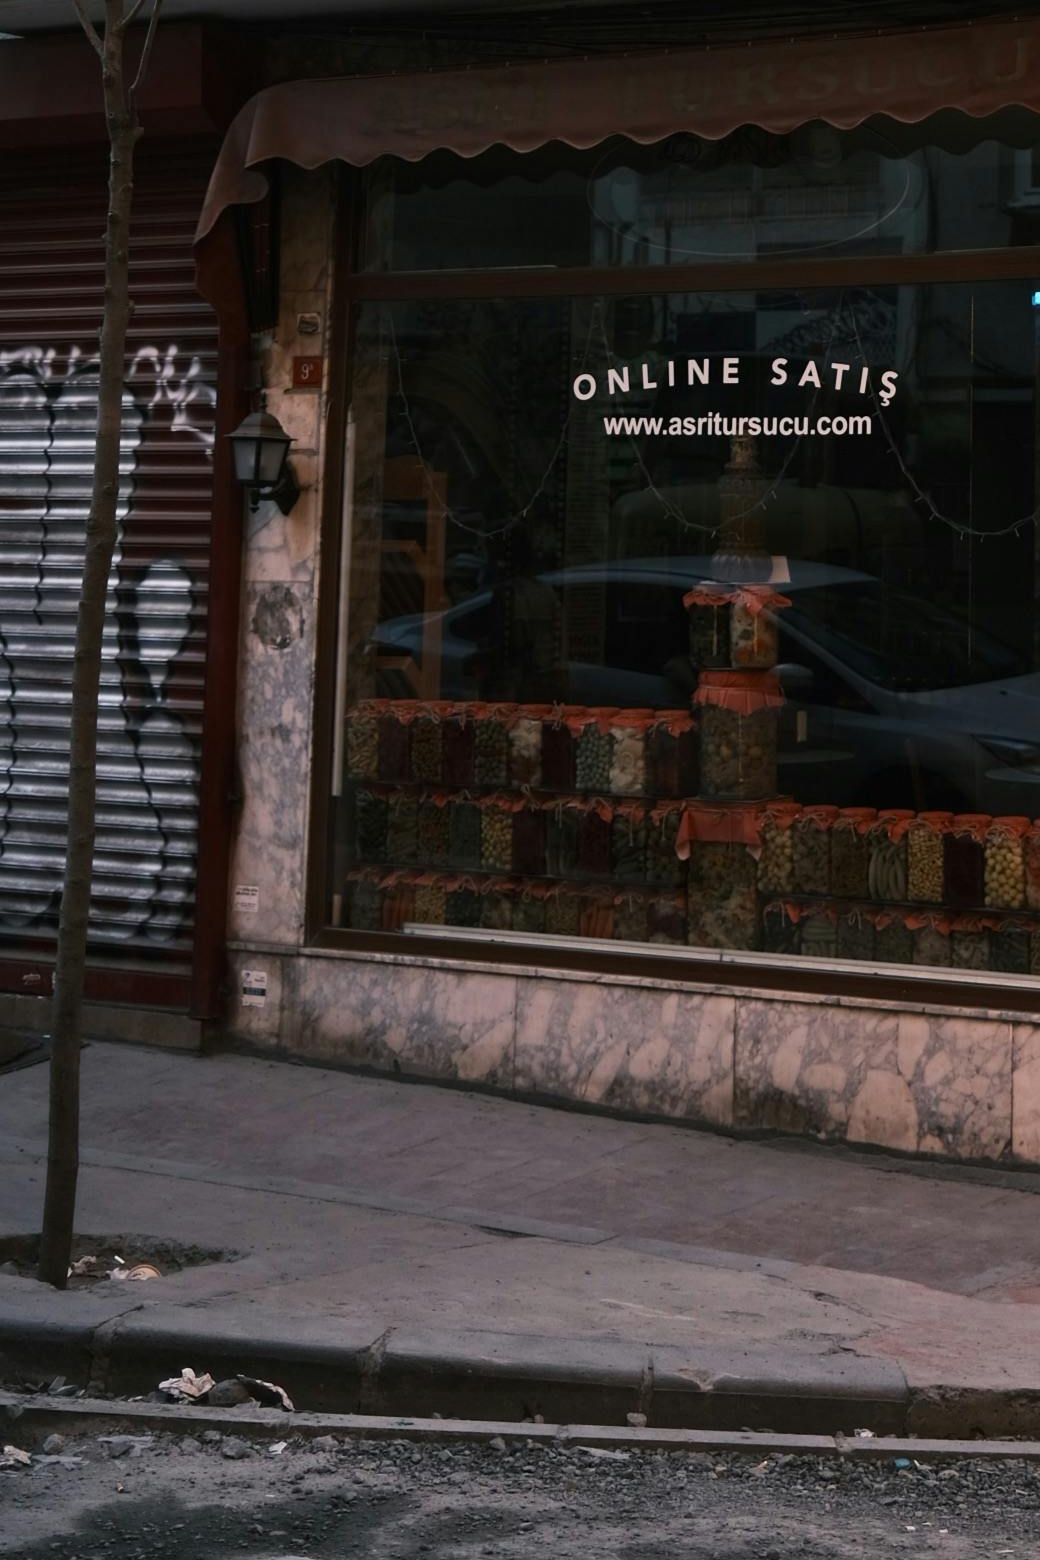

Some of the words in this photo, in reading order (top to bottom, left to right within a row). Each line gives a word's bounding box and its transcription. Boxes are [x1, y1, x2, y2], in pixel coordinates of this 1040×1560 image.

[573, 358, 740, 400] ONLINE
[770, 358, 899, 406] SATIŞ
[603, 412, 872, 436] www.asritursucu.com
